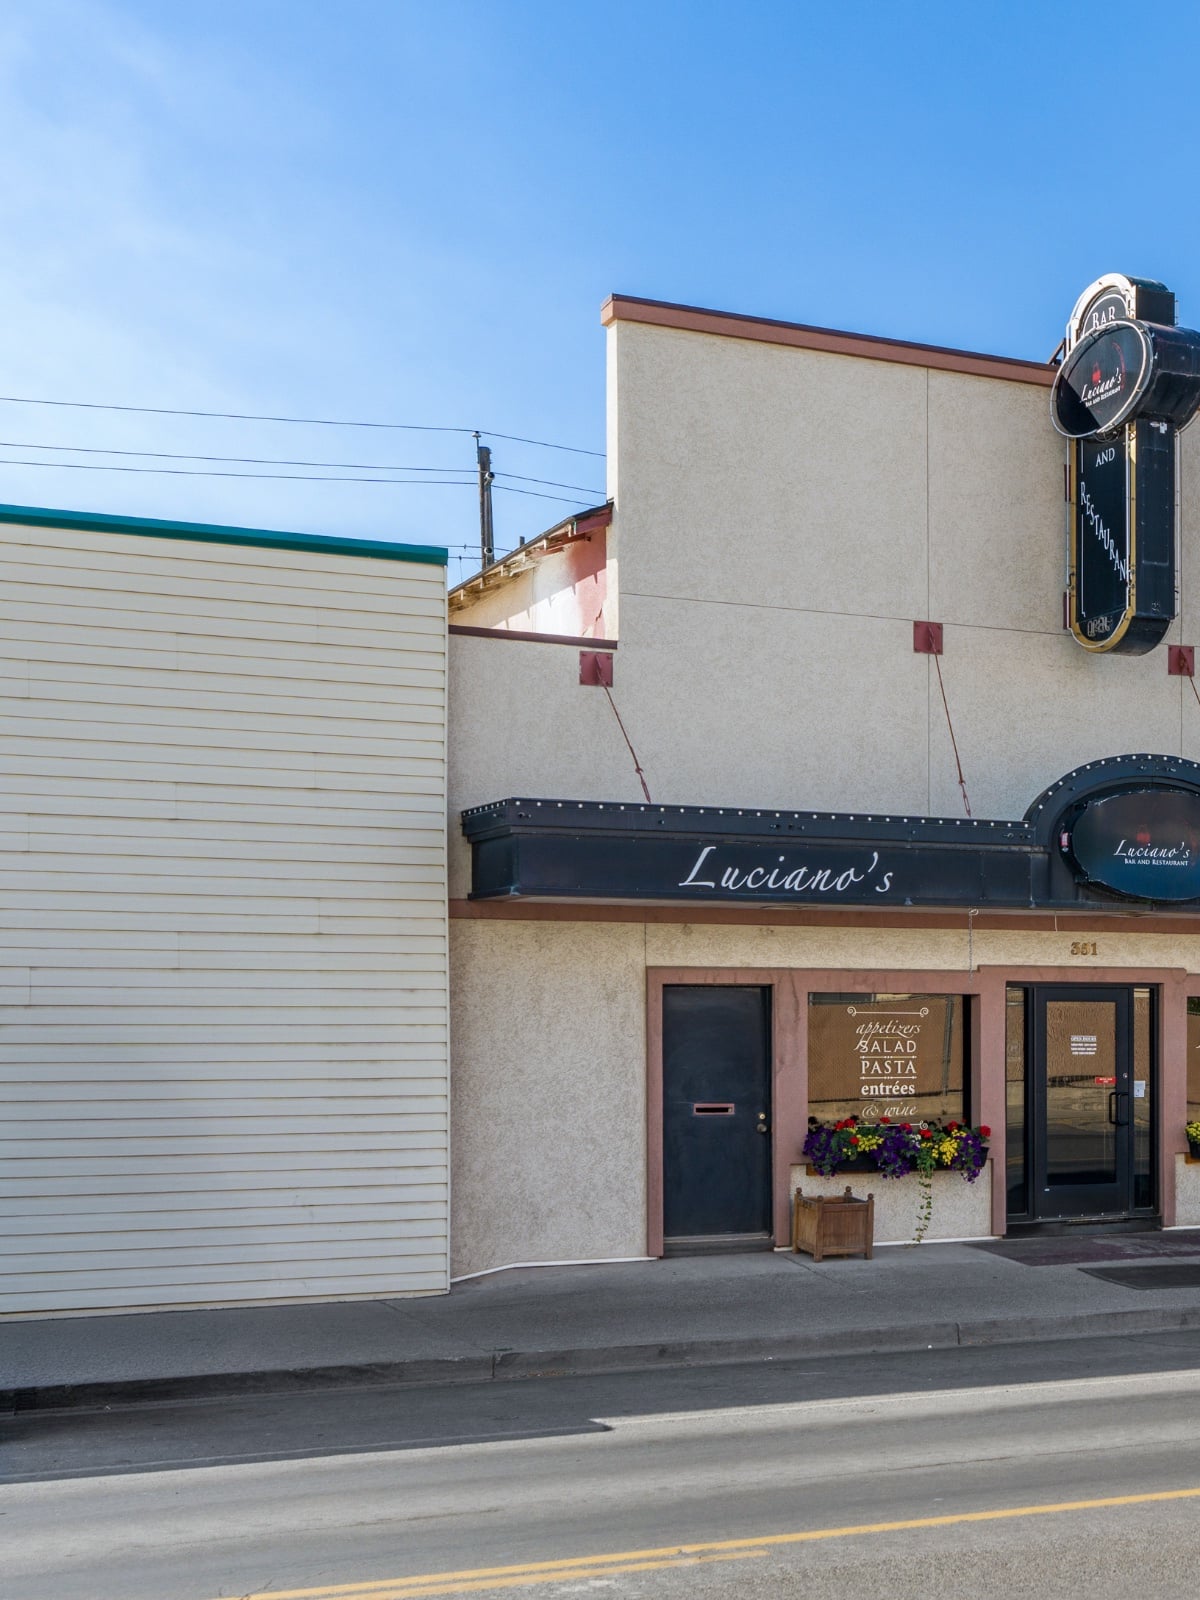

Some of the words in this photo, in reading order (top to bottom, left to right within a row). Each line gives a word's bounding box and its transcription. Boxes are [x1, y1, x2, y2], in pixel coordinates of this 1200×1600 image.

[1092, 306, 1115, 329] BAR
[1080, 367, 1122, 402] Luciano's
[1095, 447, 1116, 468] AND
[1113, 839, 1191, 859] Luciano's
[678, 846, 894, 893] Luciano's
[1070, 941, 1098, 956] 351
[853, 1019, 922, 1051] appetizers
[859, 1040, 917, 1053] SALAD
[861, 1060, 917, 1074] PASTA
[861, 1081, 916, 1096] entrées
[861, 1104, 879, 1119] &
[884, 1102, 918, 1117] wine
